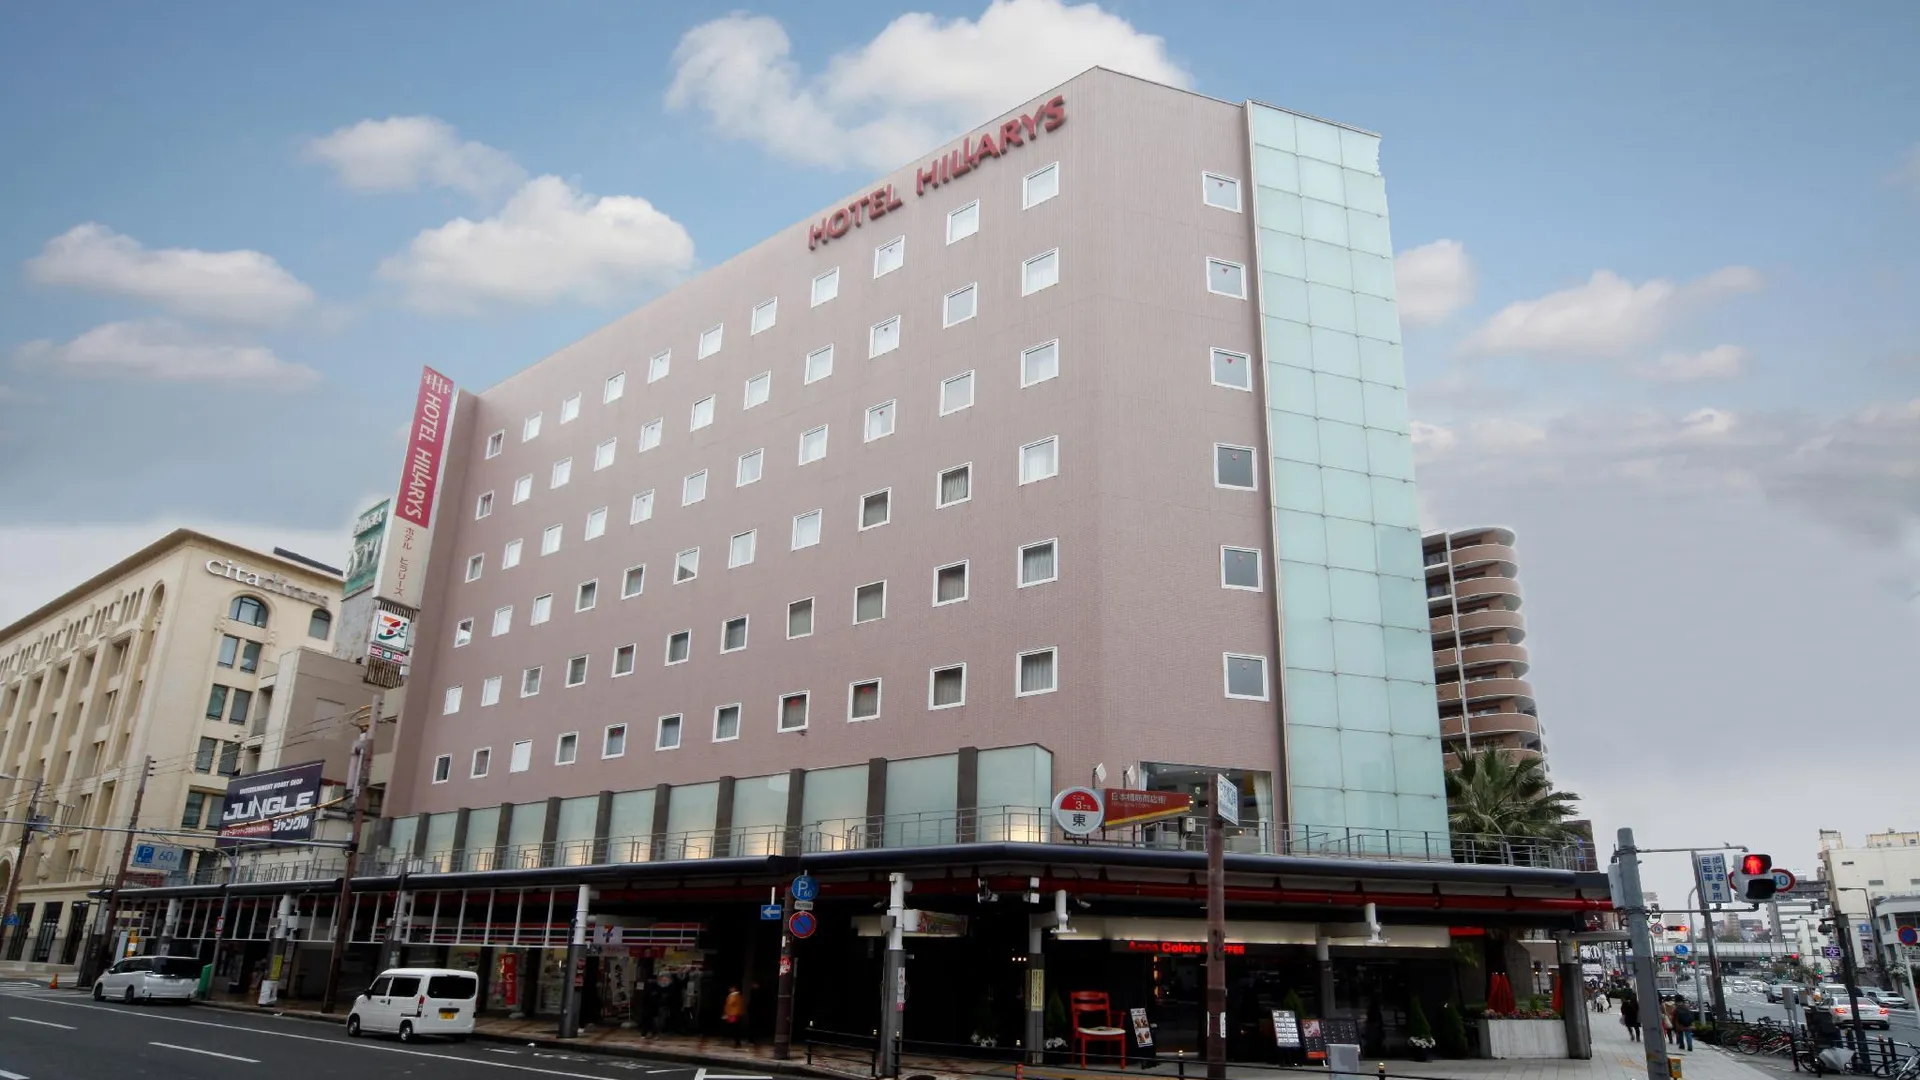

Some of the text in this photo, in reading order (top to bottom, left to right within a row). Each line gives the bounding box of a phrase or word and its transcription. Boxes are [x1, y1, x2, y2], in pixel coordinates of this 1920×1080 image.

[808, 94, 1066, 251] HOTEL HILLARYS
[404, 392, 442, 519] HOTEL HILLARYS
[402, 527, 415, 550] ホテル
[205, 560, 329, 609] citadines
[223, 791, 314, 820] JUNGLE
[272, 815, 309, 832] ジャングル
[1072, 813, 1086, 827] 東
[143, 847, 152, 857] P
[798, 880, 808, 897] P
